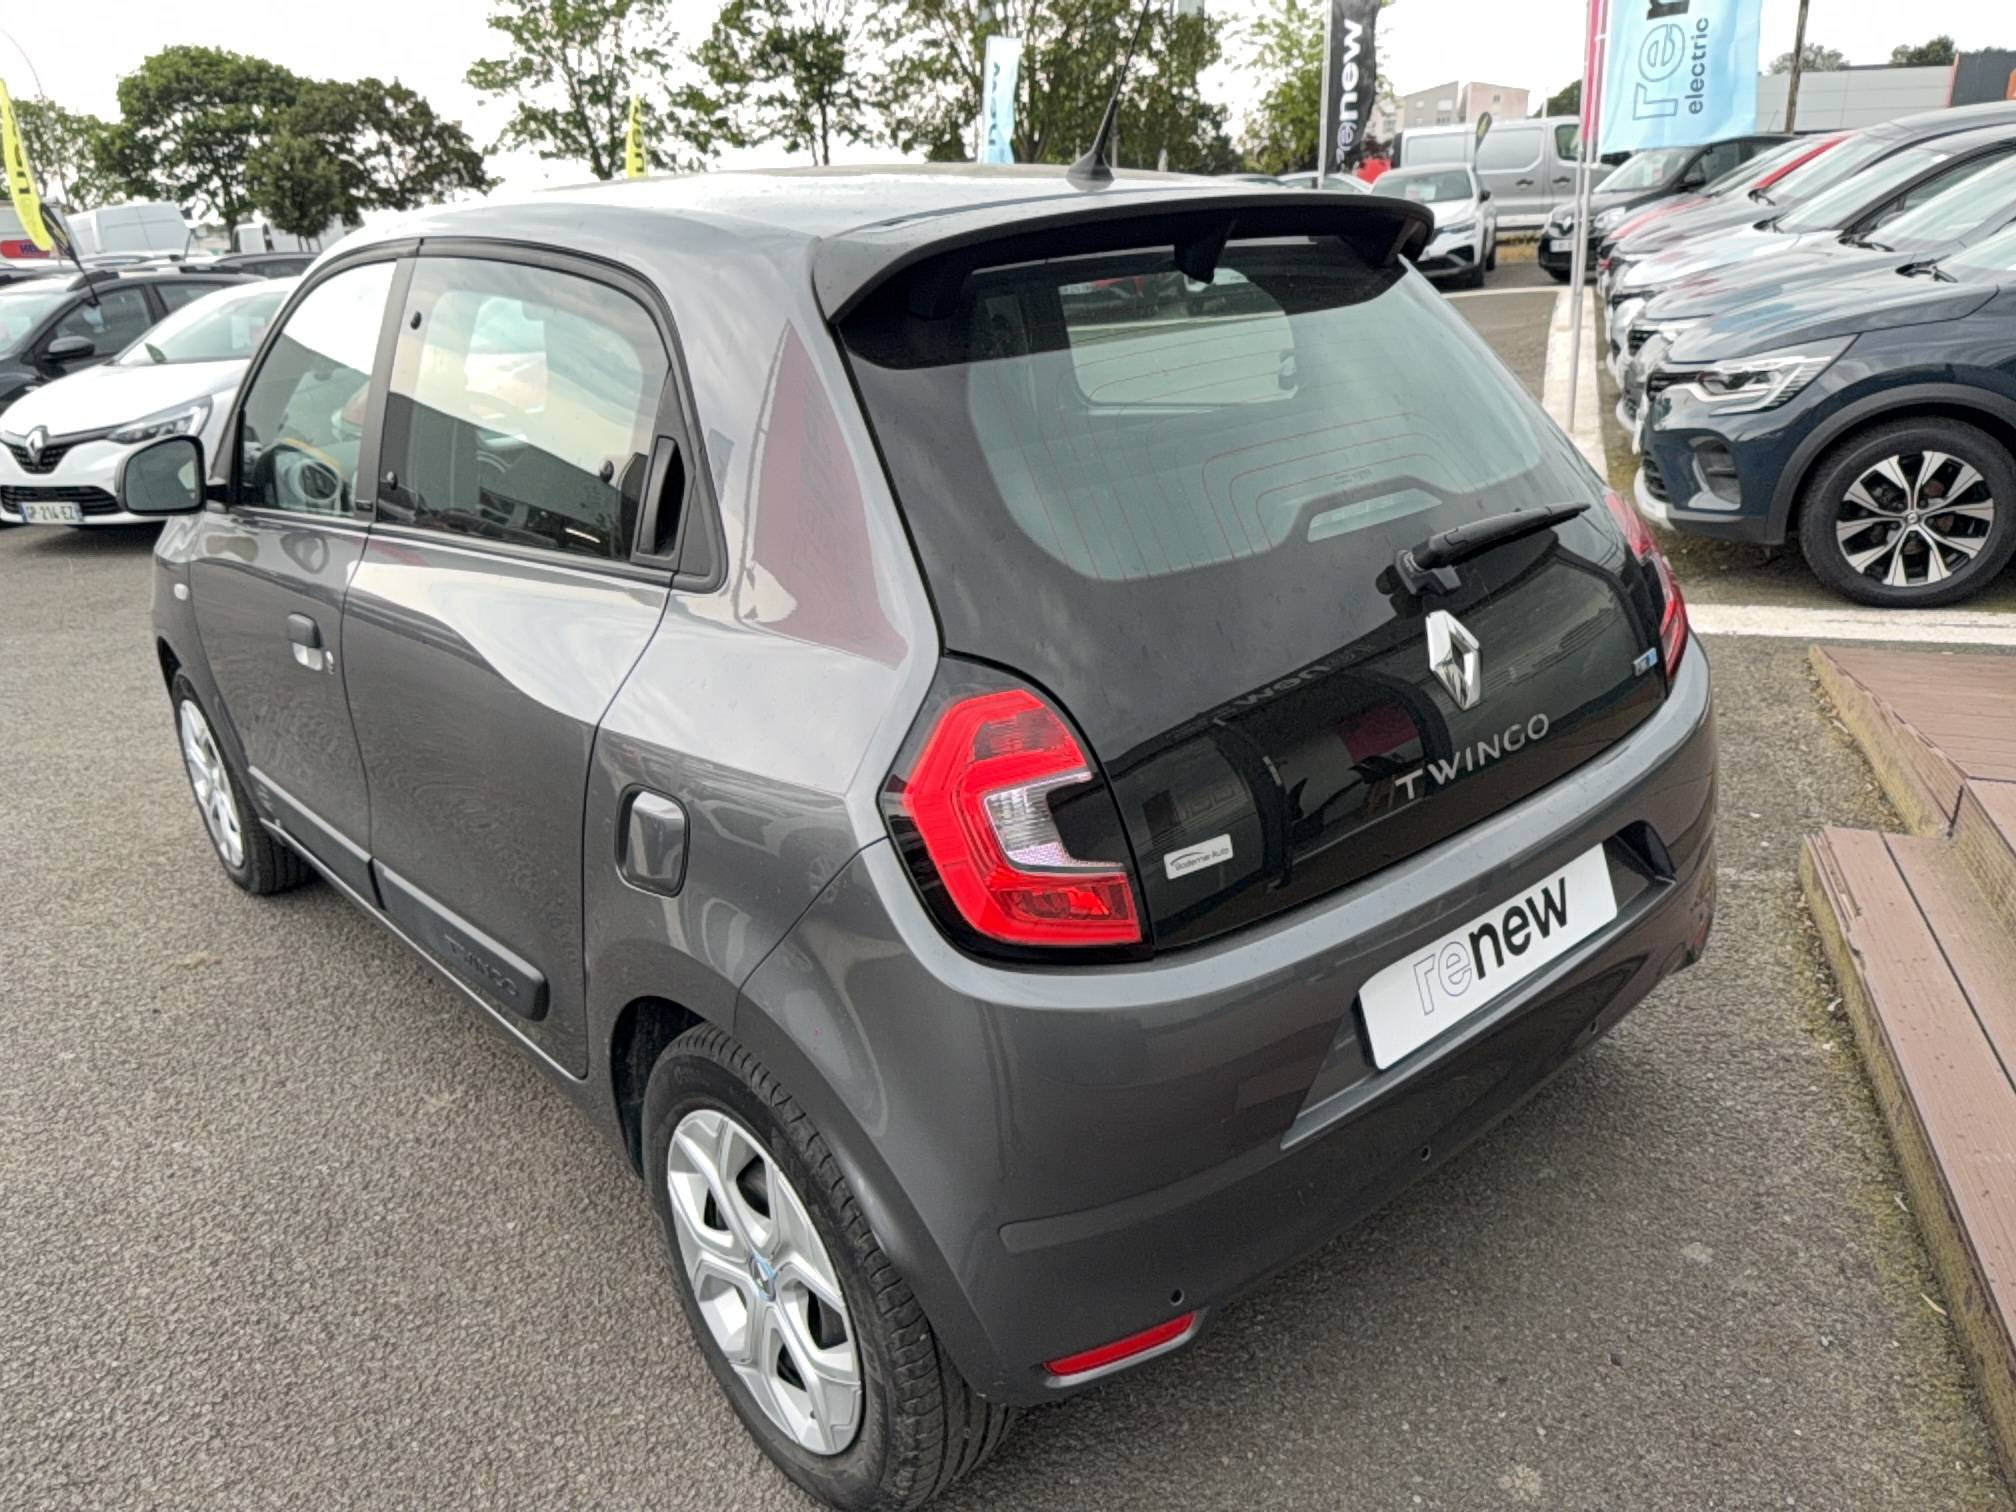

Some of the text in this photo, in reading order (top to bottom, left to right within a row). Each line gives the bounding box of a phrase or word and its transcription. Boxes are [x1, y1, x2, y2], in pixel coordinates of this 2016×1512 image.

[1684, 17, 1709, 115] electric
[1394, 713, 1549, 801] TWINGO
[1412, 876, 1567, 1016] renew
